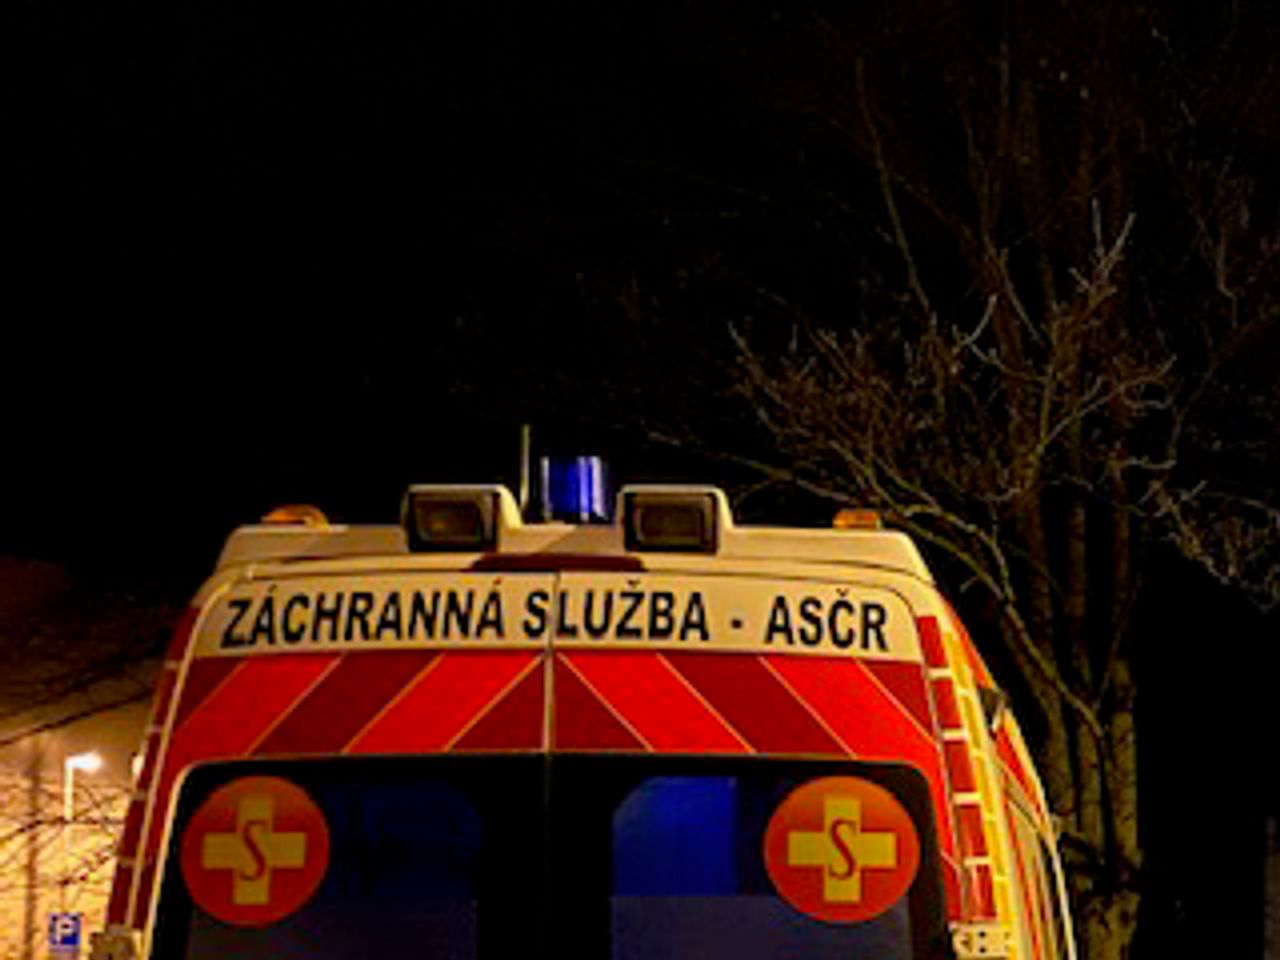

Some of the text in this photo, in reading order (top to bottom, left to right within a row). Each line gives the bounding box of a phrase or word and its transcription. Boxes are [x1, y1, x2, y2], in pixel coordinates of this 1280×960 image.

[220, 578, 506, 648] ZÁCHRANNÁ
[522, 580, 710, 641] SLUŽBA
[763, 588, 890, 651] ASČR
